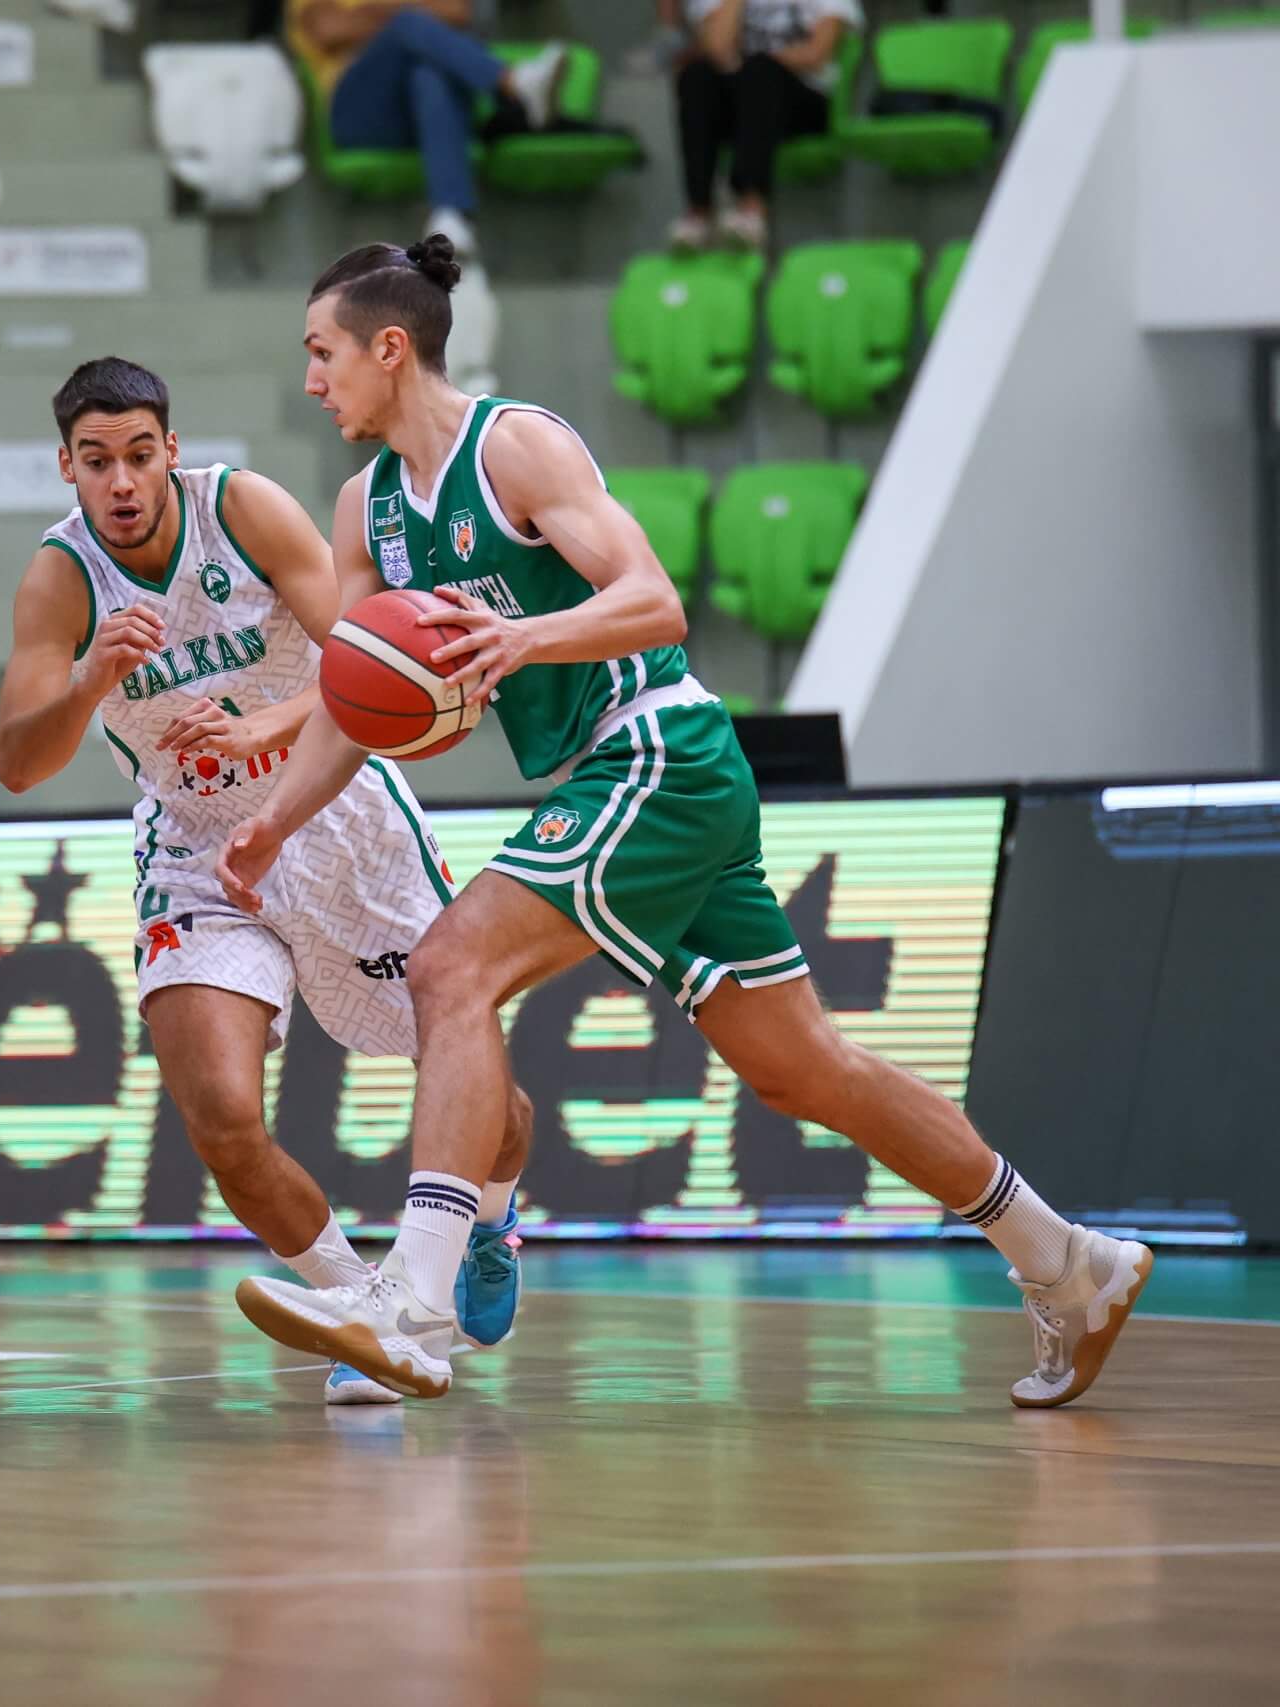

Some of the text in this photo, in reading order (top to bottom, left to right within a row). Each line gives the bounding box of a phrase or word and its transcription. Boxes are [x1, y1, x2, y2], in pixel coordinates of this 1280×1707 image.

[122, 625, 267, 701] BALKAN
[412, 1199, 469, 1220] Wilson
[980, 1184, 1020, 1229] Wilson
